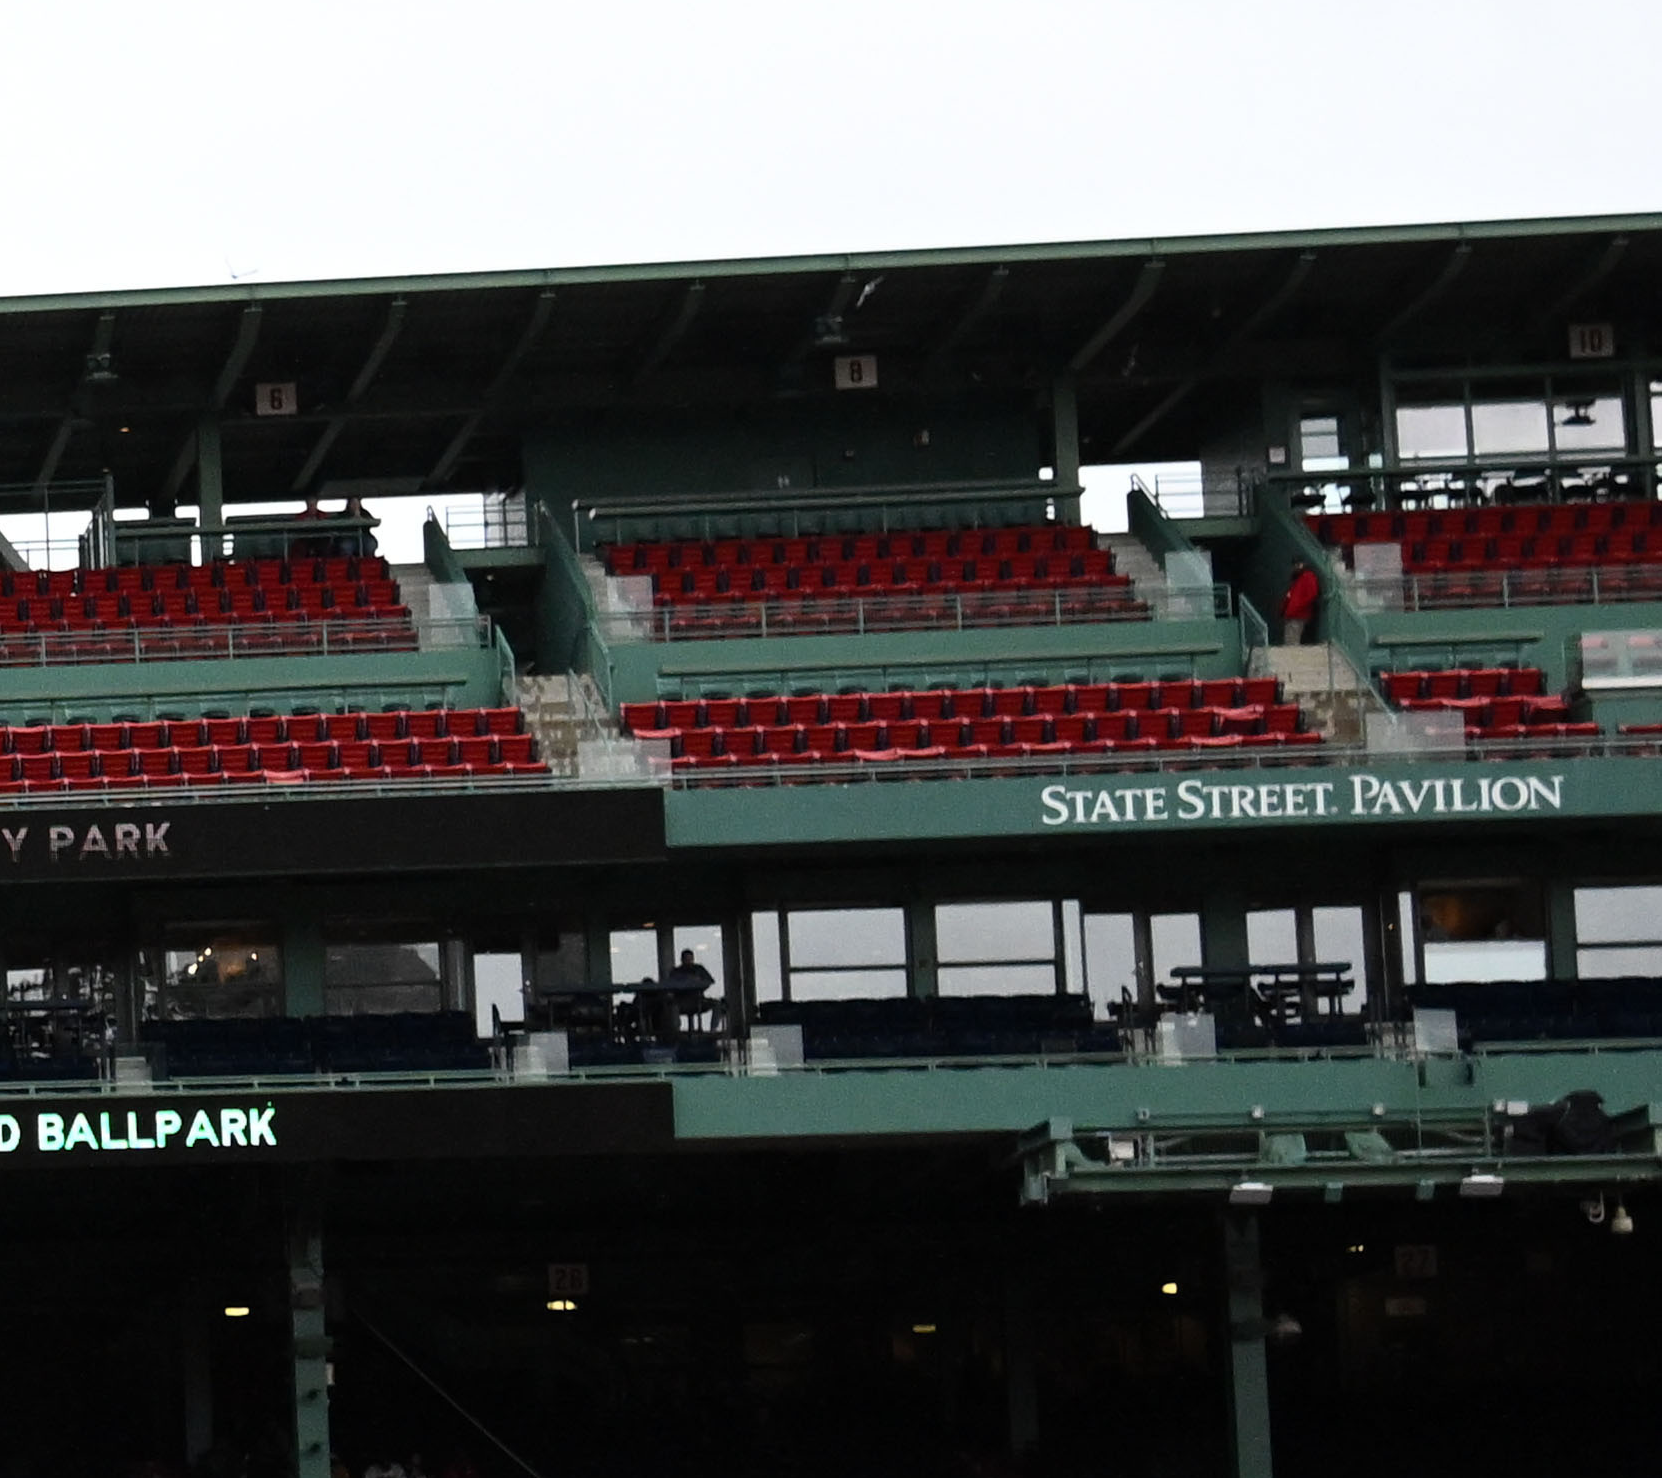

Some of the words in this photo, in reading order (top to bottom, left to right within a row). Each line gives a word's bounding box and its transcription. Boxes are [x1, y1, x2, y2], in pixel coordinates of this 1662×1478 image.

[1580, 329, 1602, 352] 10
[1041, 785, 1167, 824] STATE
[1177, 780, 1333, 821] STREET
[1349, 774, 1564, 814] PAVILION
[49, 821, 172, 861] PARK
[38, 1107, 276, 1151] BALLPARK
